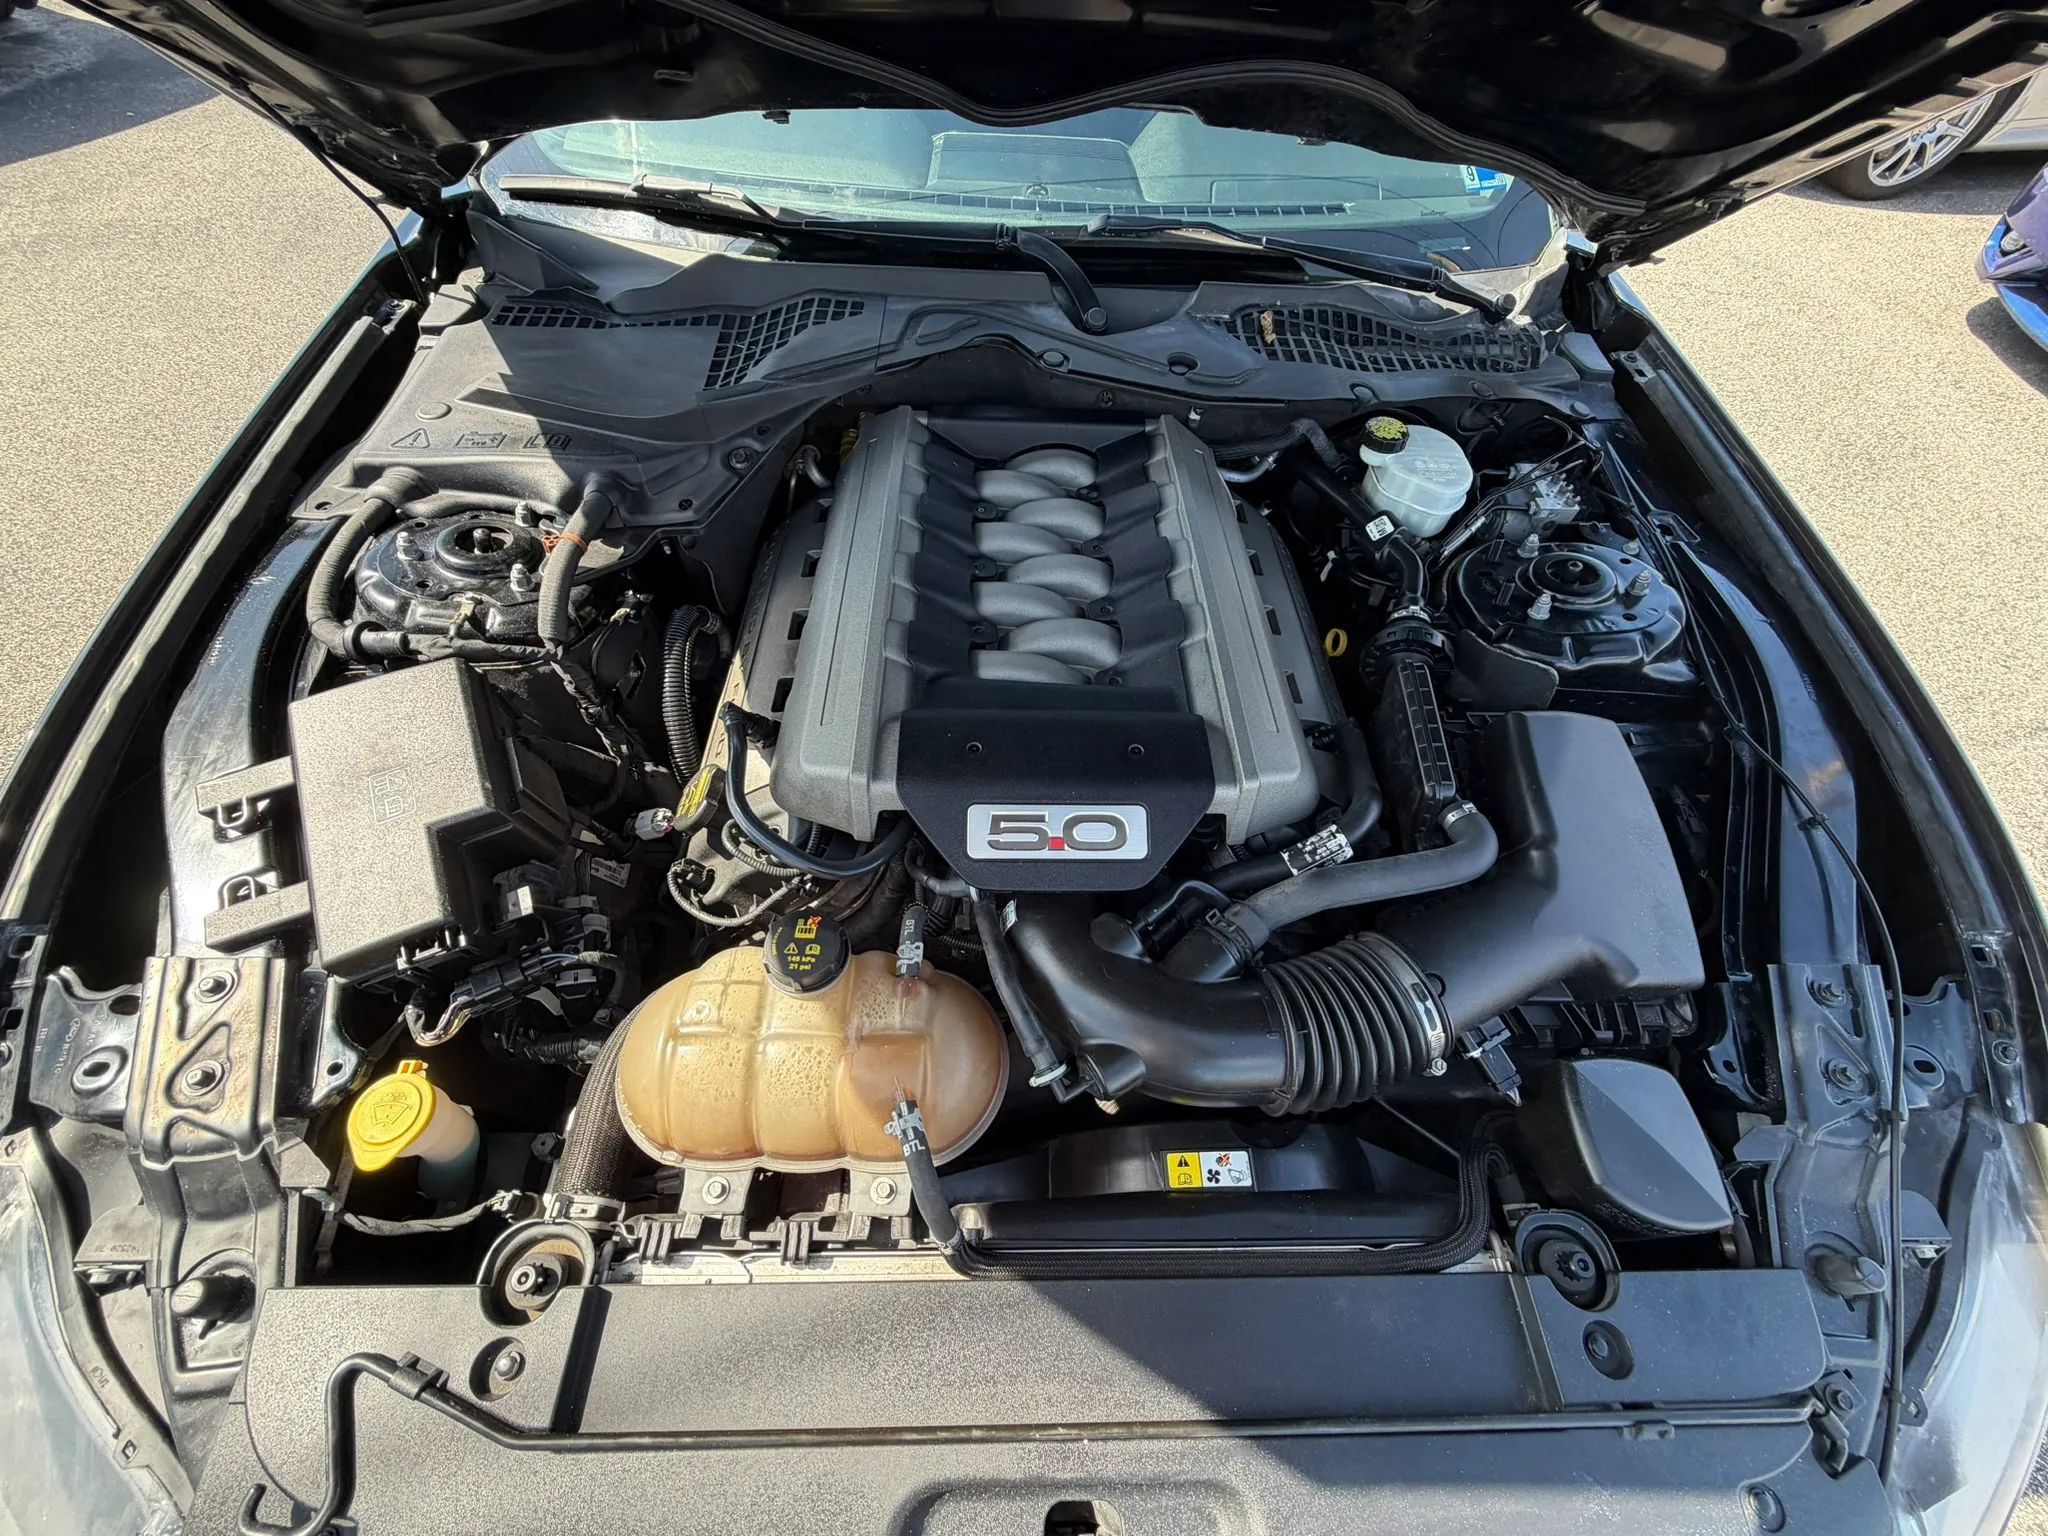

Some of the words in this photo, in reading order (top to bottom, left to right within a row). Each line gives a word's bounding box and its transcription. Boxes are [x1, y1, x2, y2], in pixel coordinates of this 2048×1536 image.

[986, 811, 1129, 851] 5.0
[799, 963, 811, 971] psi
[903, 1139, 926, 1157] BTL
